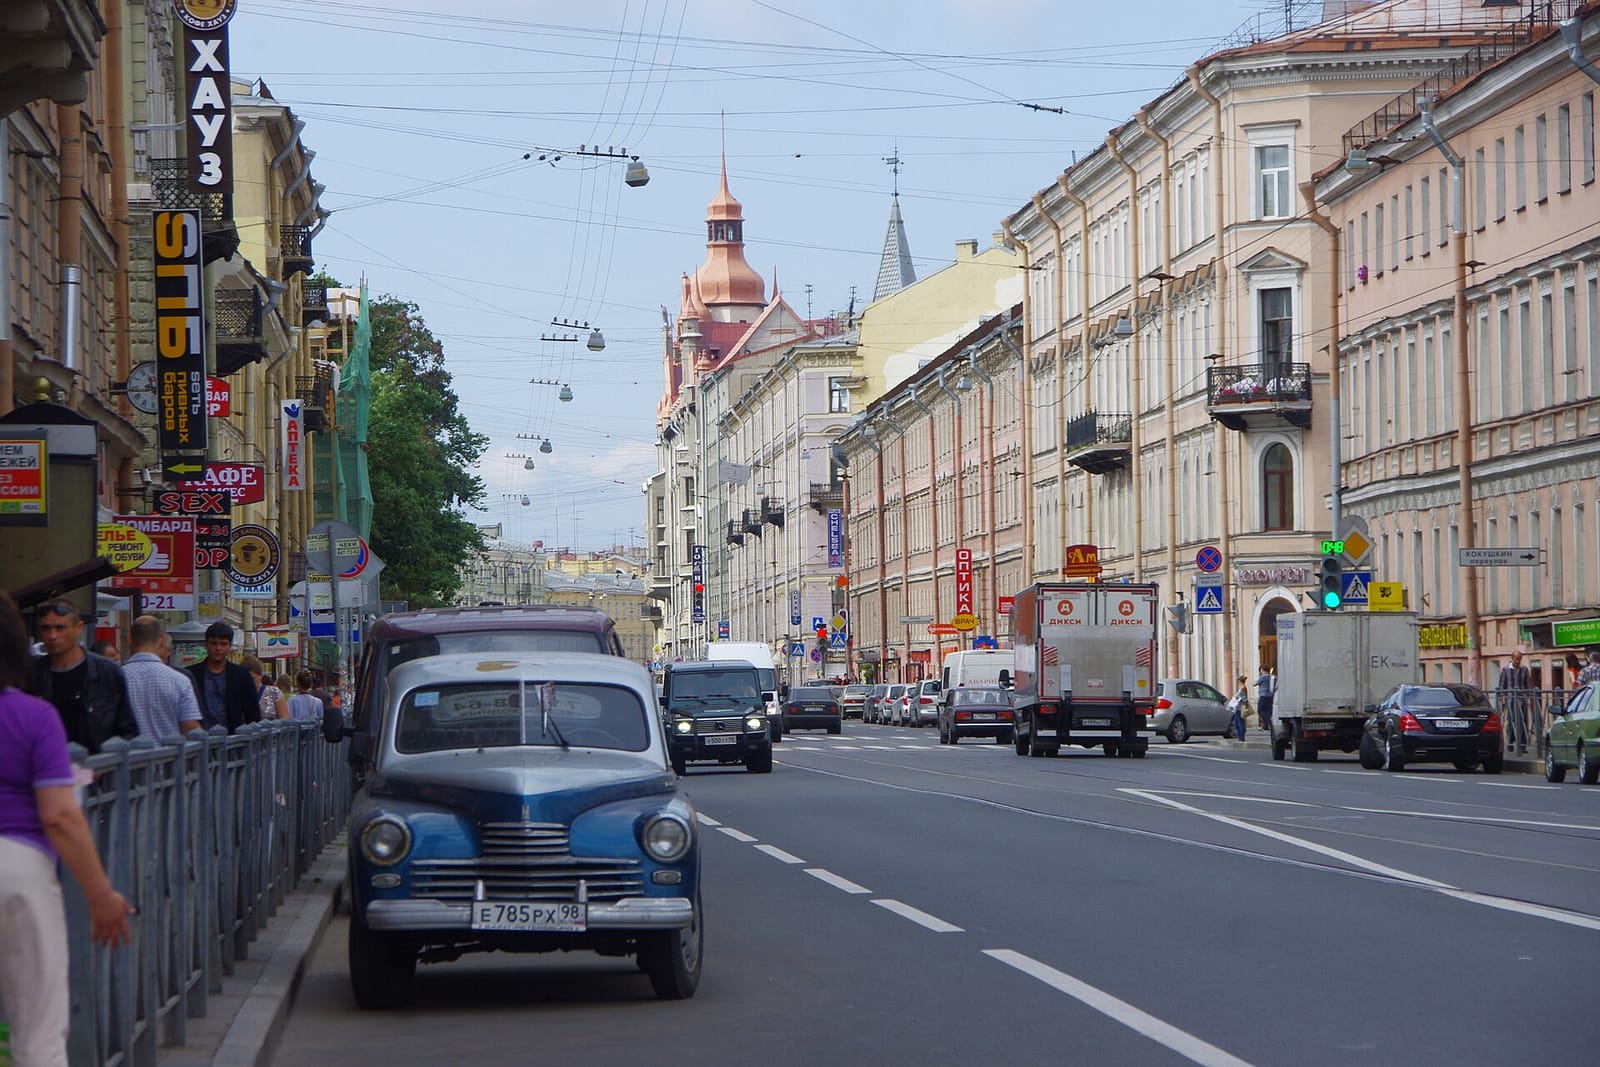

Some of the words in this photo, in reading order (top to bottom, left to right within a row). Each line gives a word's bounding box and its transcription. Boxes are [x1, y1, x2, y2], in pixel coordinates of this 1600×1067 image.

[183, 14, 205, 27] КОФЕ
[207, 14, 227, 27] ХАУЗ
[190, 39, 225, 186] ХАУЗ
[162, 371, 176, 431] баров
[177, 371, 189, 444] пивных
[287, 420, 299, 487] АПТЕКА
[185, 467, 257, 486] АФЕ
[160, 492, 224, 513] SEX
[830, 513, 839, 555] CHELSEA
[108, 543, 145, 552] РЕМОНТ
[115, 552, 145, 561] ОБУВИ
[230, 570, 250, 583] КОФЕ
[252, 570, 271, 583] ХАУЗ
[959, 550, 970, 613] ОПТИКА
[1110, 618, 1143, 626] ДИКСИ
[480, 904, 557, 923] Е785РХ
[561, 905, 579, 919] 98
